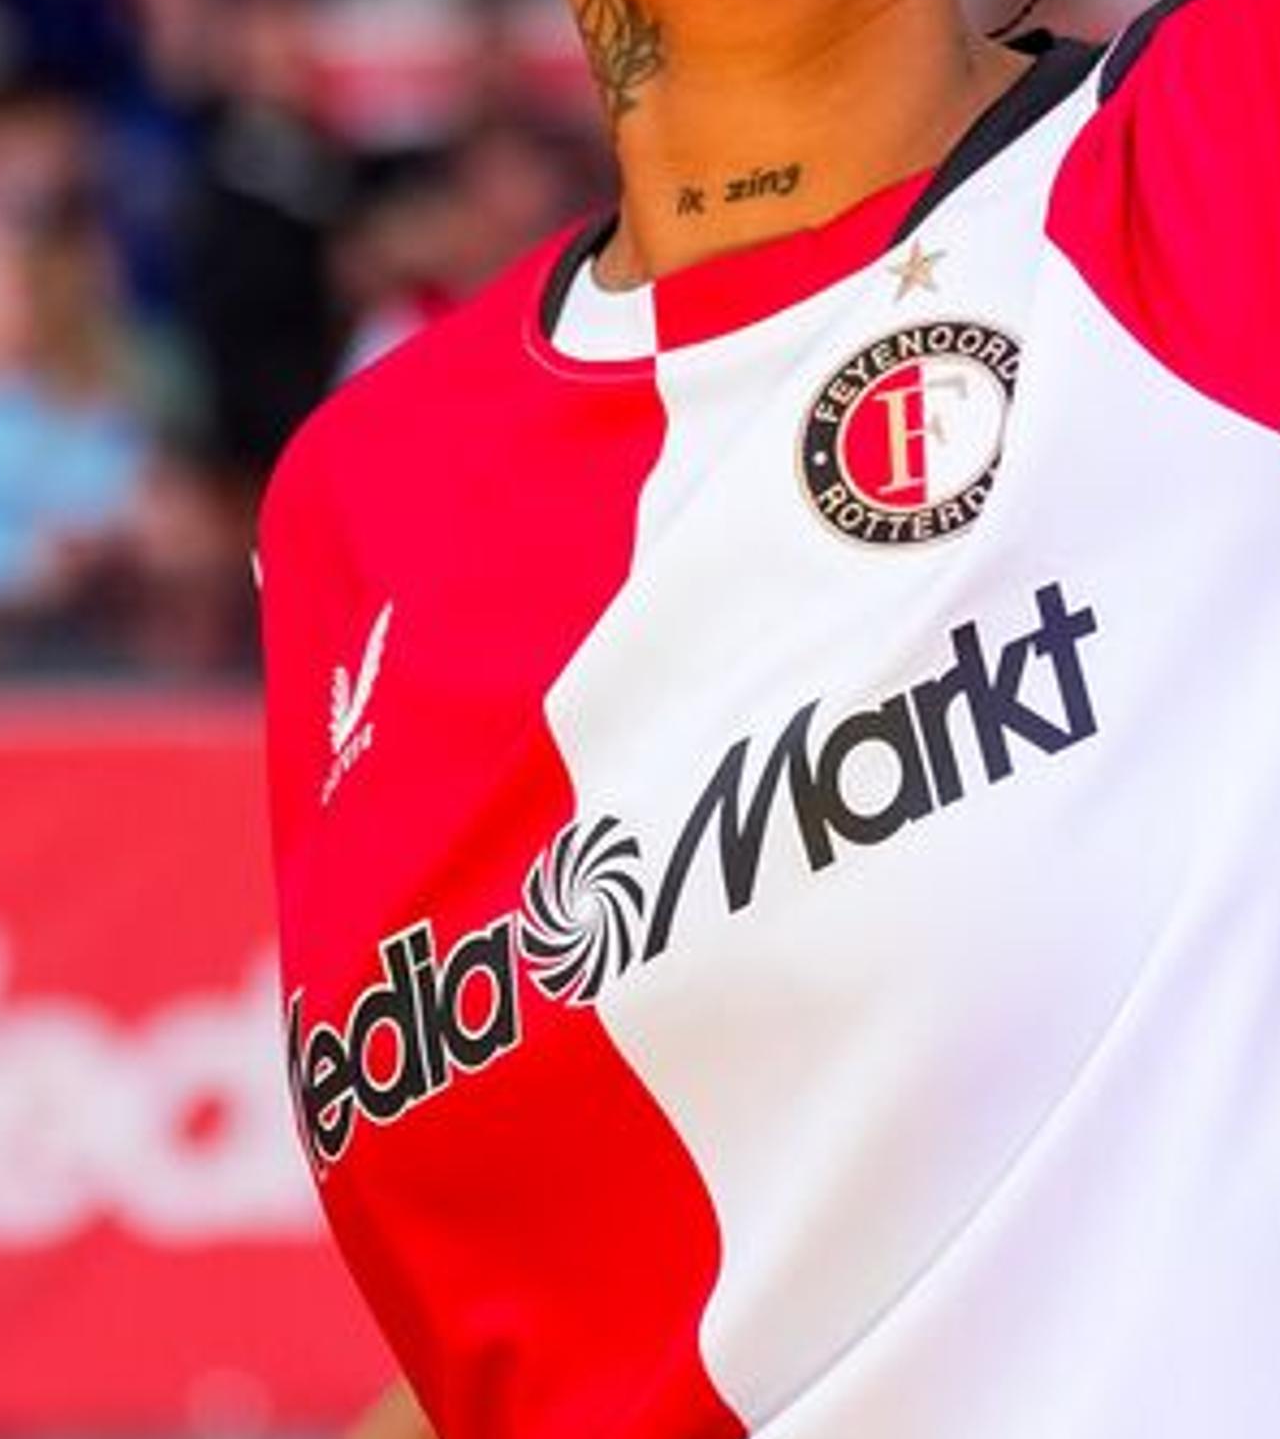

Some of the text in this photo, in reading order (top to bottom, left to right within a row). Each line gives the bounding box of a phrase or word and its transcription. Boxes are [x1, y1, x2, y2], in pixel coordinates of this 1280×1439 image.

[818, 478, 990, 541] ROTTERD
[286, 581, 1098, 1183] edia Markt
